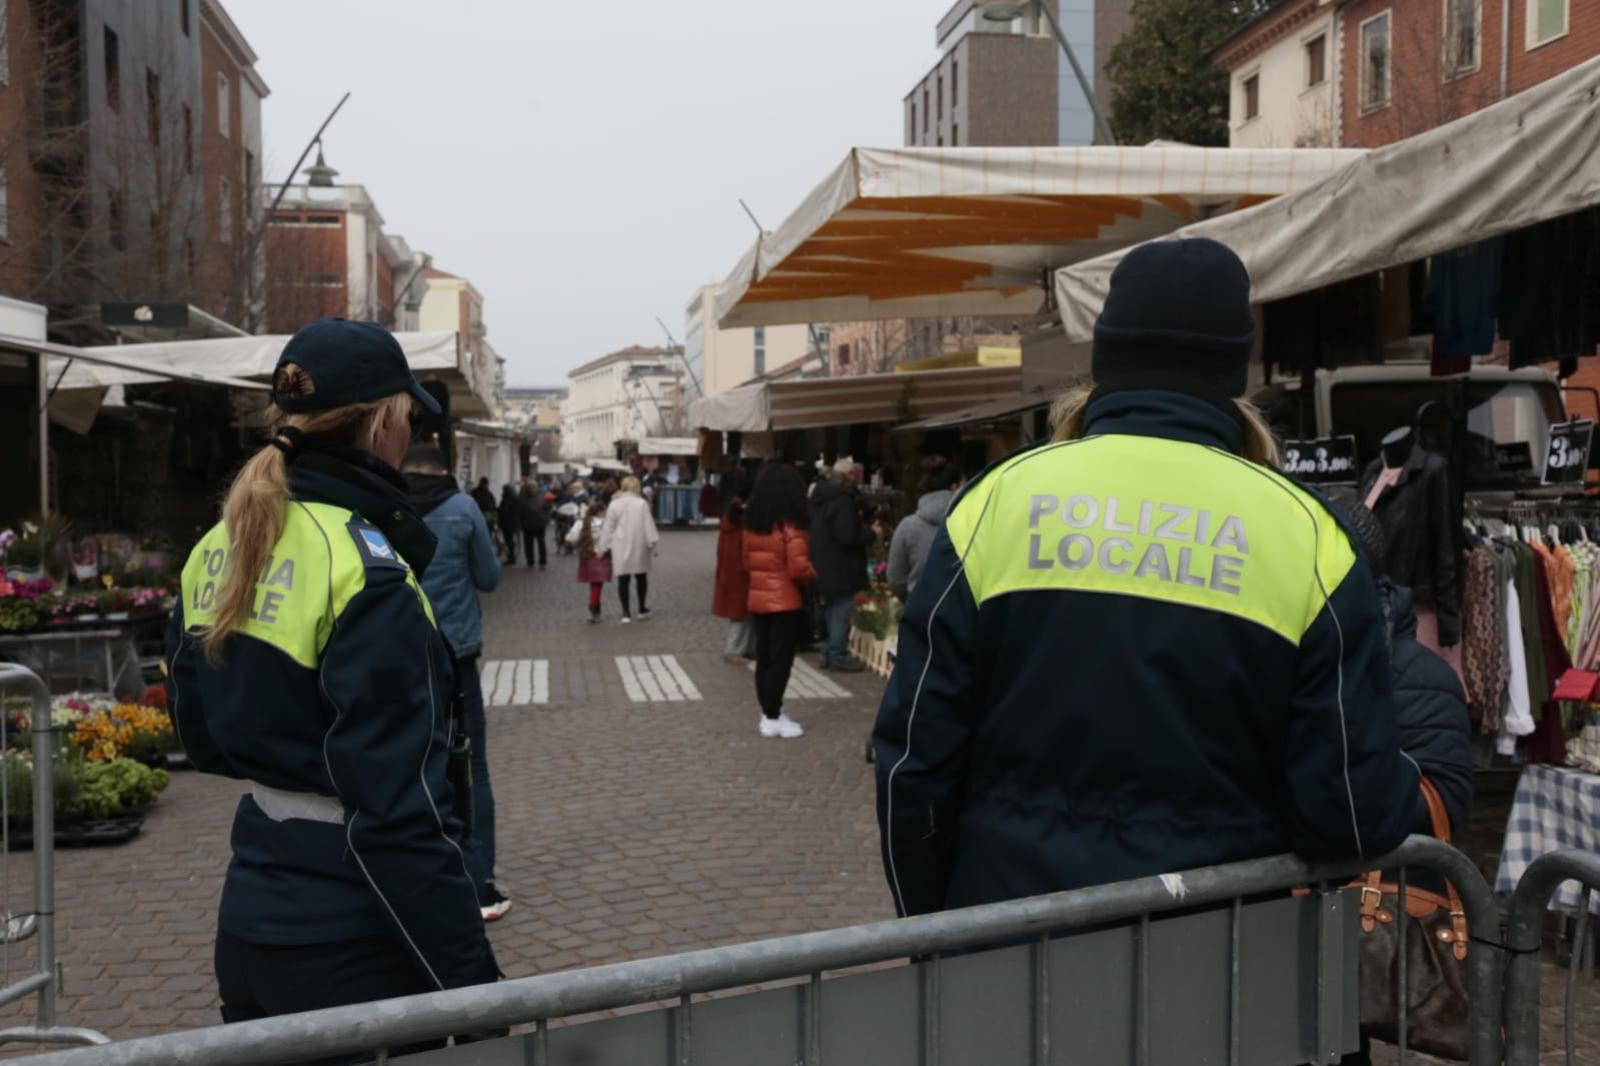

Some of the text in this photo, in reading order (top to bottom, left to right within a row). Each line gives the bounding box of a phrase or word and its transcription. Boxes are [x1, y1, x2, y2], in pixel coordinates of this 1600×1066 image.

[1028, 494, 1249, 554] POLIZIA
[1028, 533, 1245, 596] LOCALE
[192, 581, 285, 624] LOLE
